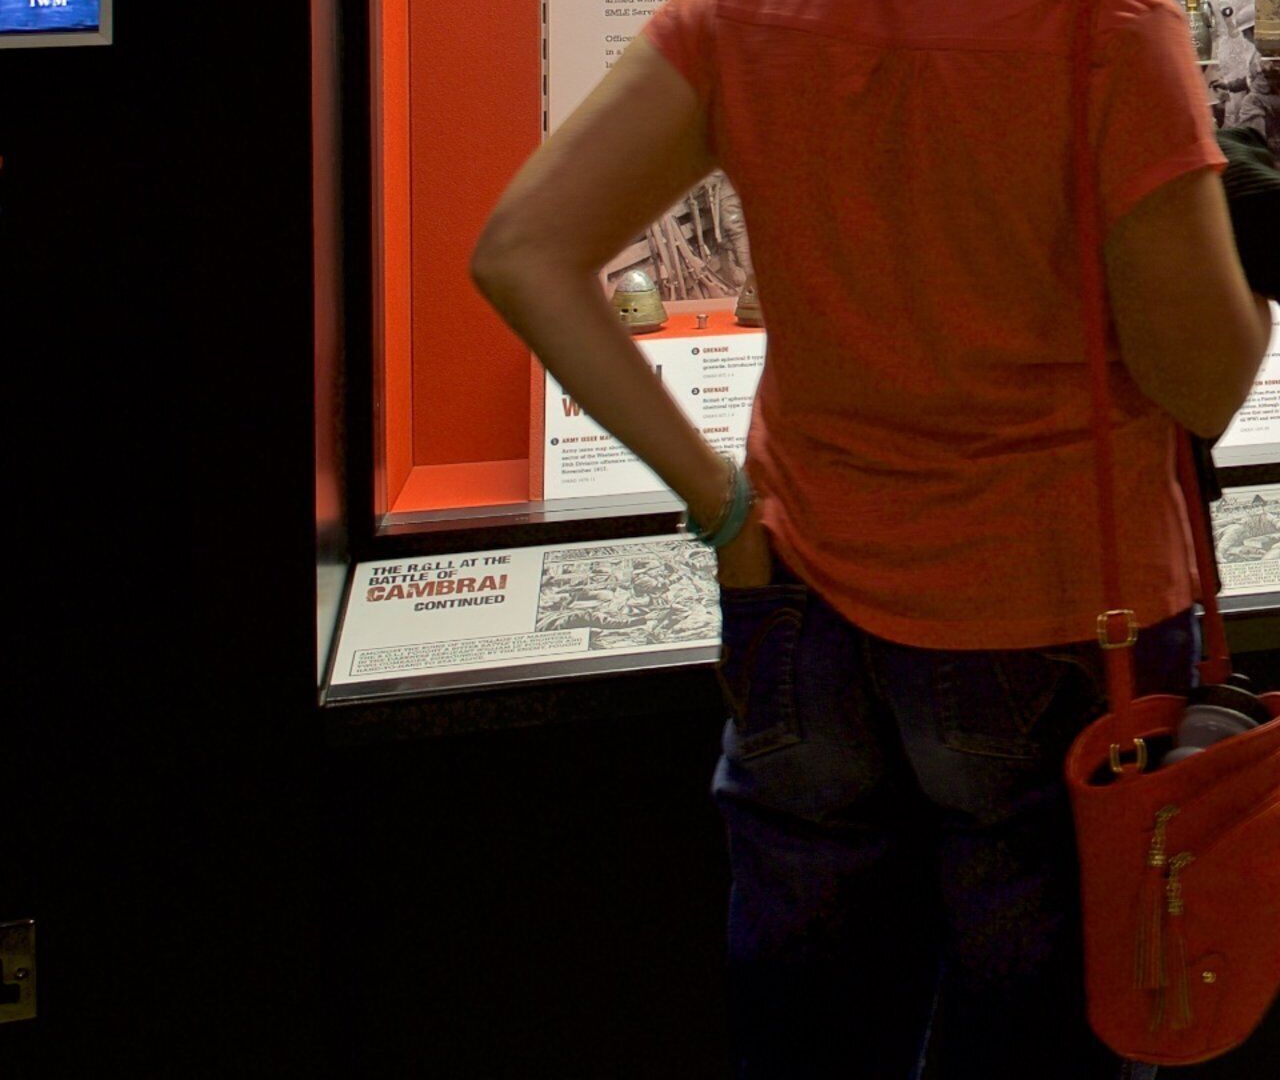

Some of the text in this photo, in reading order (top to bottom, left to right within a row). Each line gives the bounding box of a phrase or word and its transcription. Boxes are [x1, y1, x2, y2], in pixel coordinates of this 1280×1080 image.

[372, 565, 402, 575] THE
[460, 558, 478, 568] AT
[483, 555, 511, 565] THE
[369, 570, 458, 586] BATTLE OF
[366, 574, 508, 602] CAMBRAI
[414, 595, 505, 611] CONTINUED
